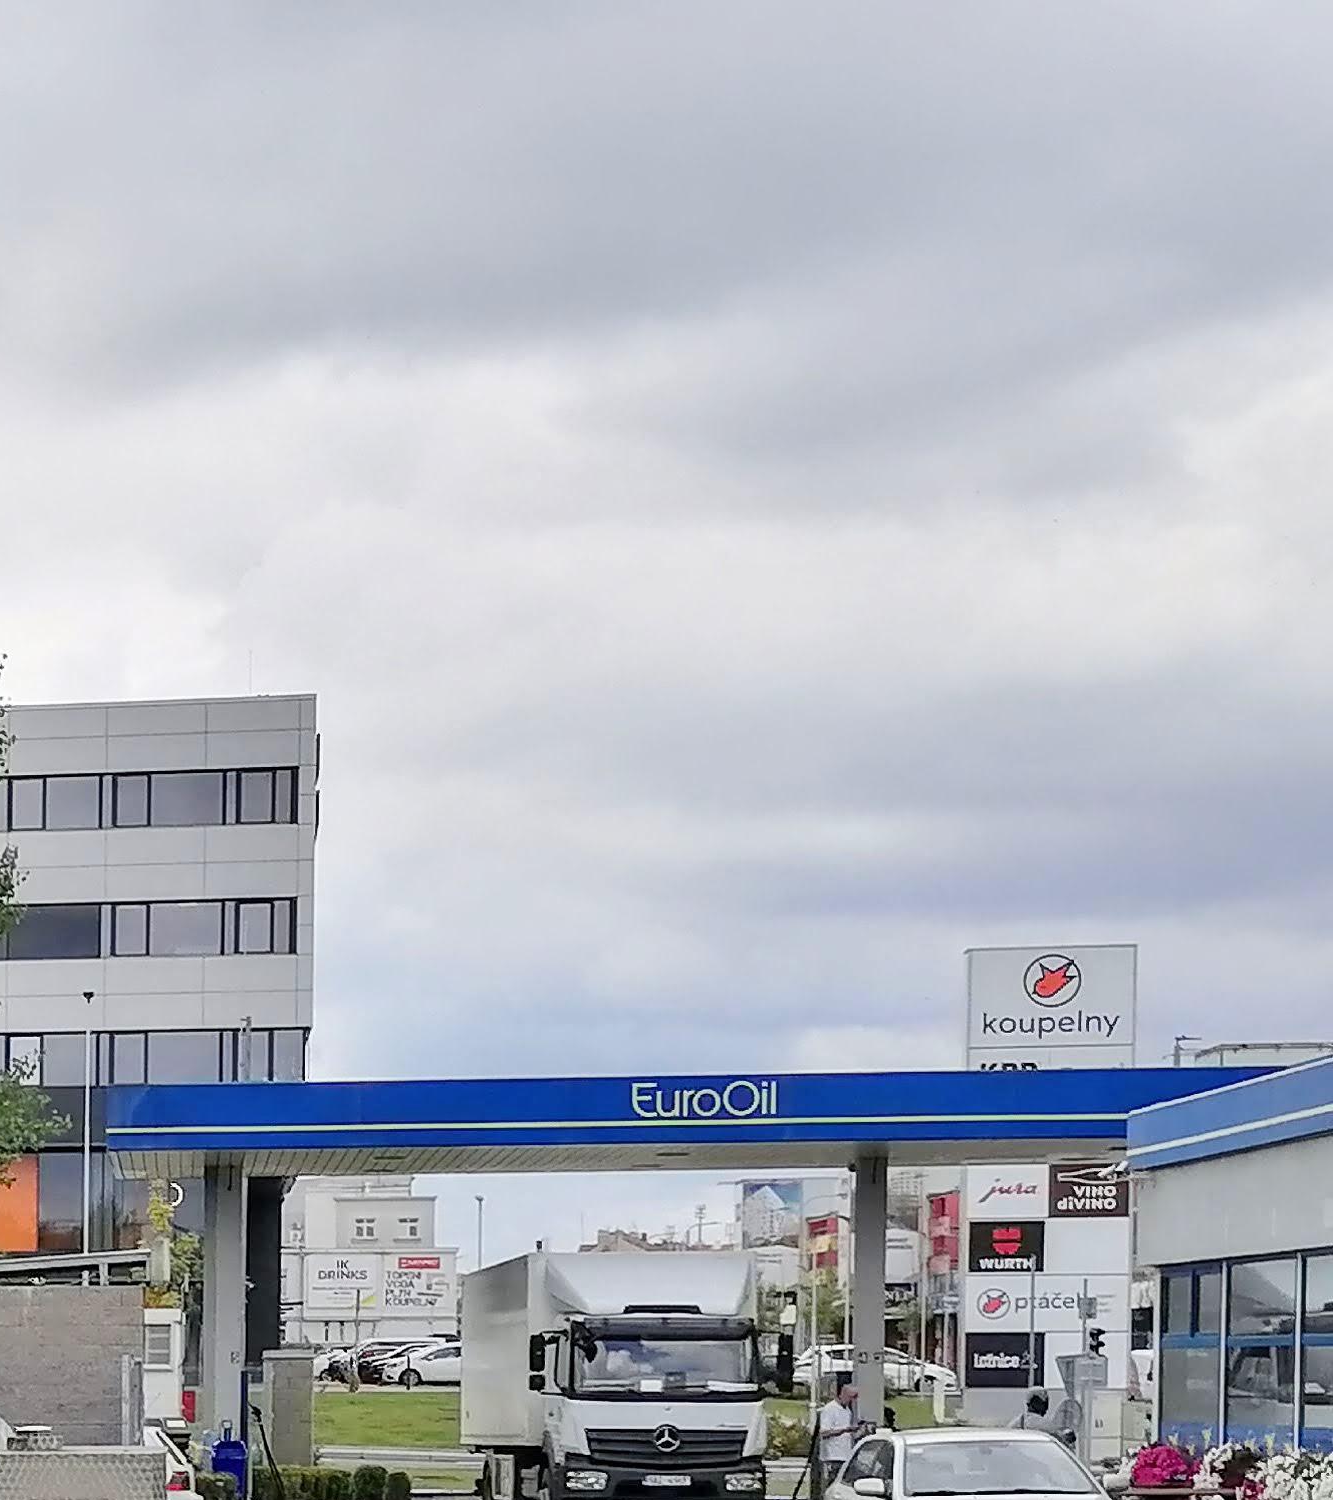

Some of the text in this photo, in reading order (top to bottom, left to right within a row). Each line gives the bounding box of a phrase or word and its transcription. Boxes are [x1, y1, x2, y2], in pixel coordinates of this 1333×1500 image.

[982, 1009, 1121, 1040] koupelny
[631, 1080, 778, 1118] EuroOil
[979, 1178, 1038, 1204] jura
[1057, 1196, 1117, 1210] diVINO
[318, 1270, 368, 1280] DRINKS
